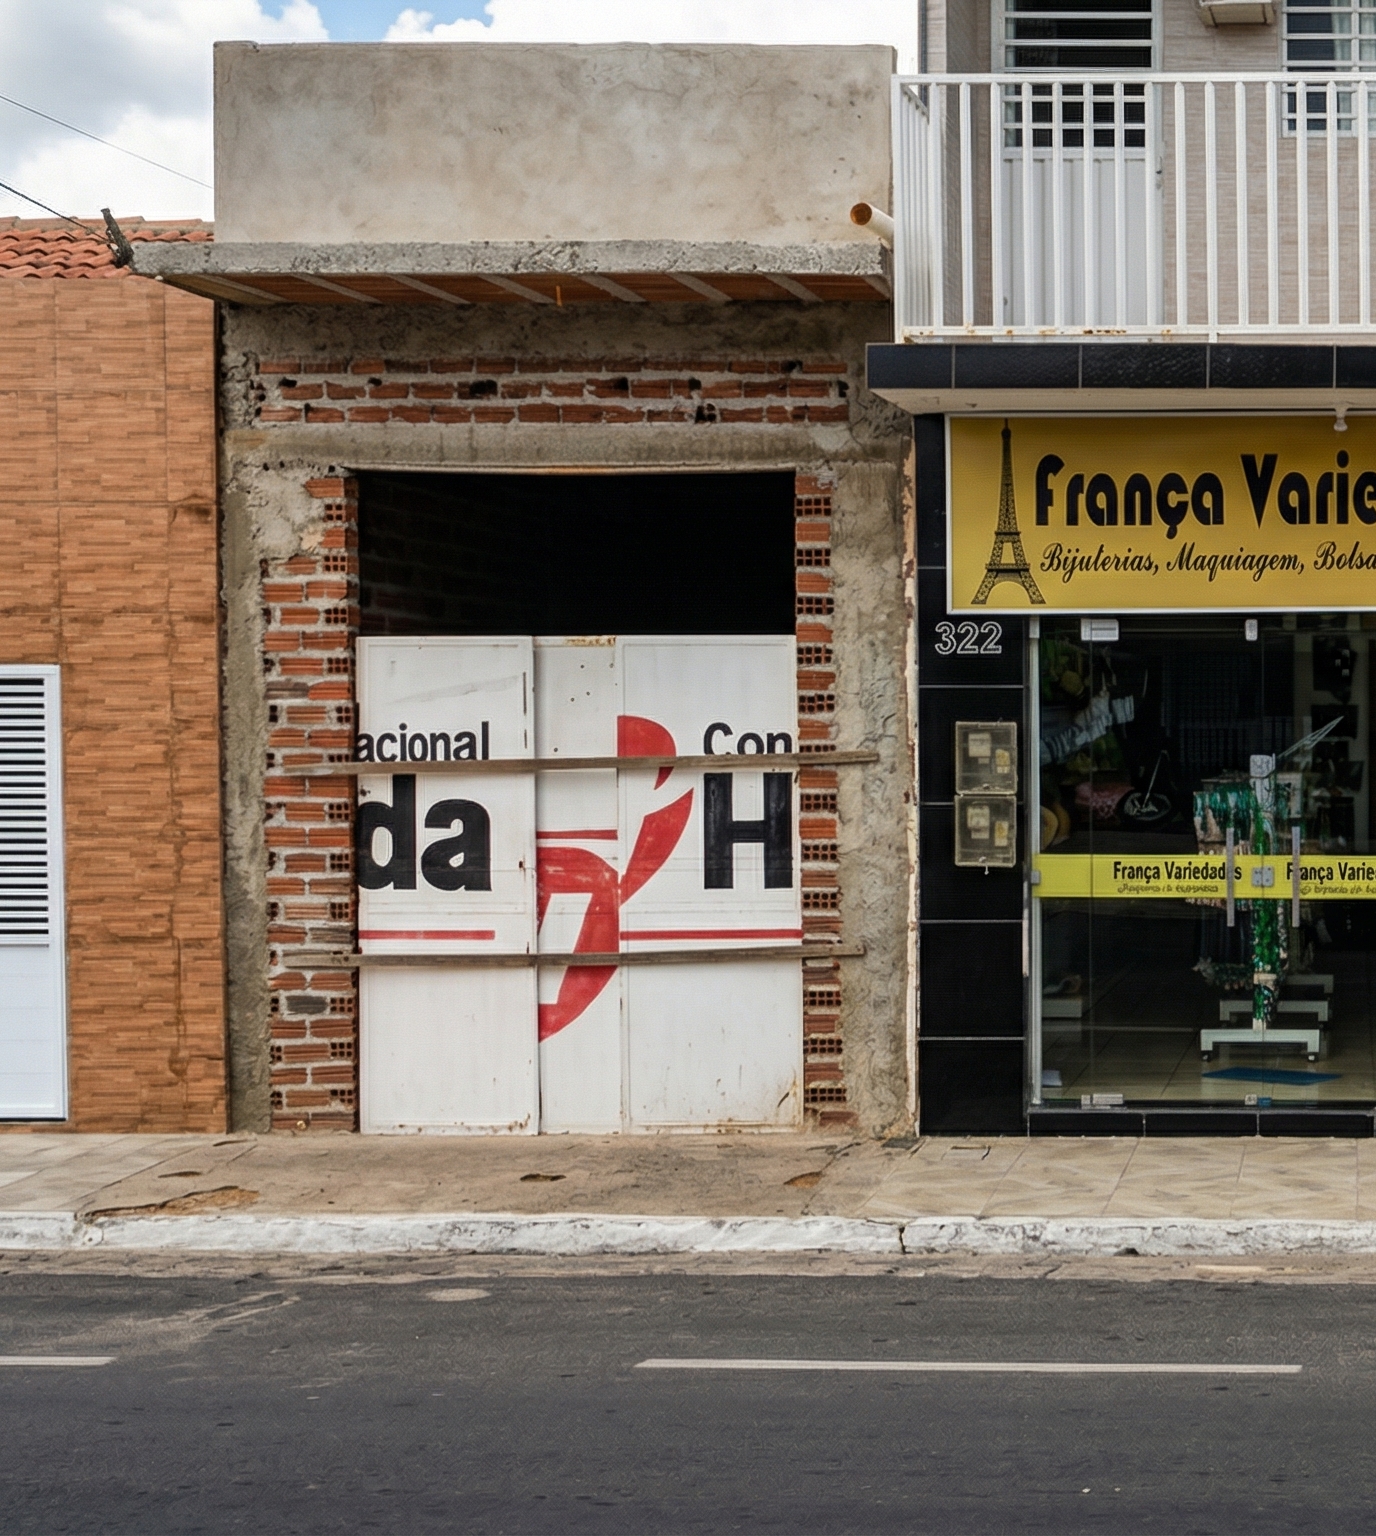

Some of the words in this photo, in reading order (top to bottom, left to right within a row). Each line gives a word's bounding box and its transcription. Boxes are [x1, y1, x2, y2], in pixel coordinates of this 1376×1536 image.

[1039, 542, 1159, 584] Bijuterias,
[1166, 541, 1304, 583] Maquiagem,
[934, 621, 1003, 655] 322
[355, 721, 489, 762] acional
[703, 722, 793, 756] Con
[357, 774, 492, 892] da
[703, 772, 793, 889] H
[1113, 861, 1161, 884] França
[1164, 861, 1243, 880] Variedads
[1286, 862, 1334, 884] Fança
